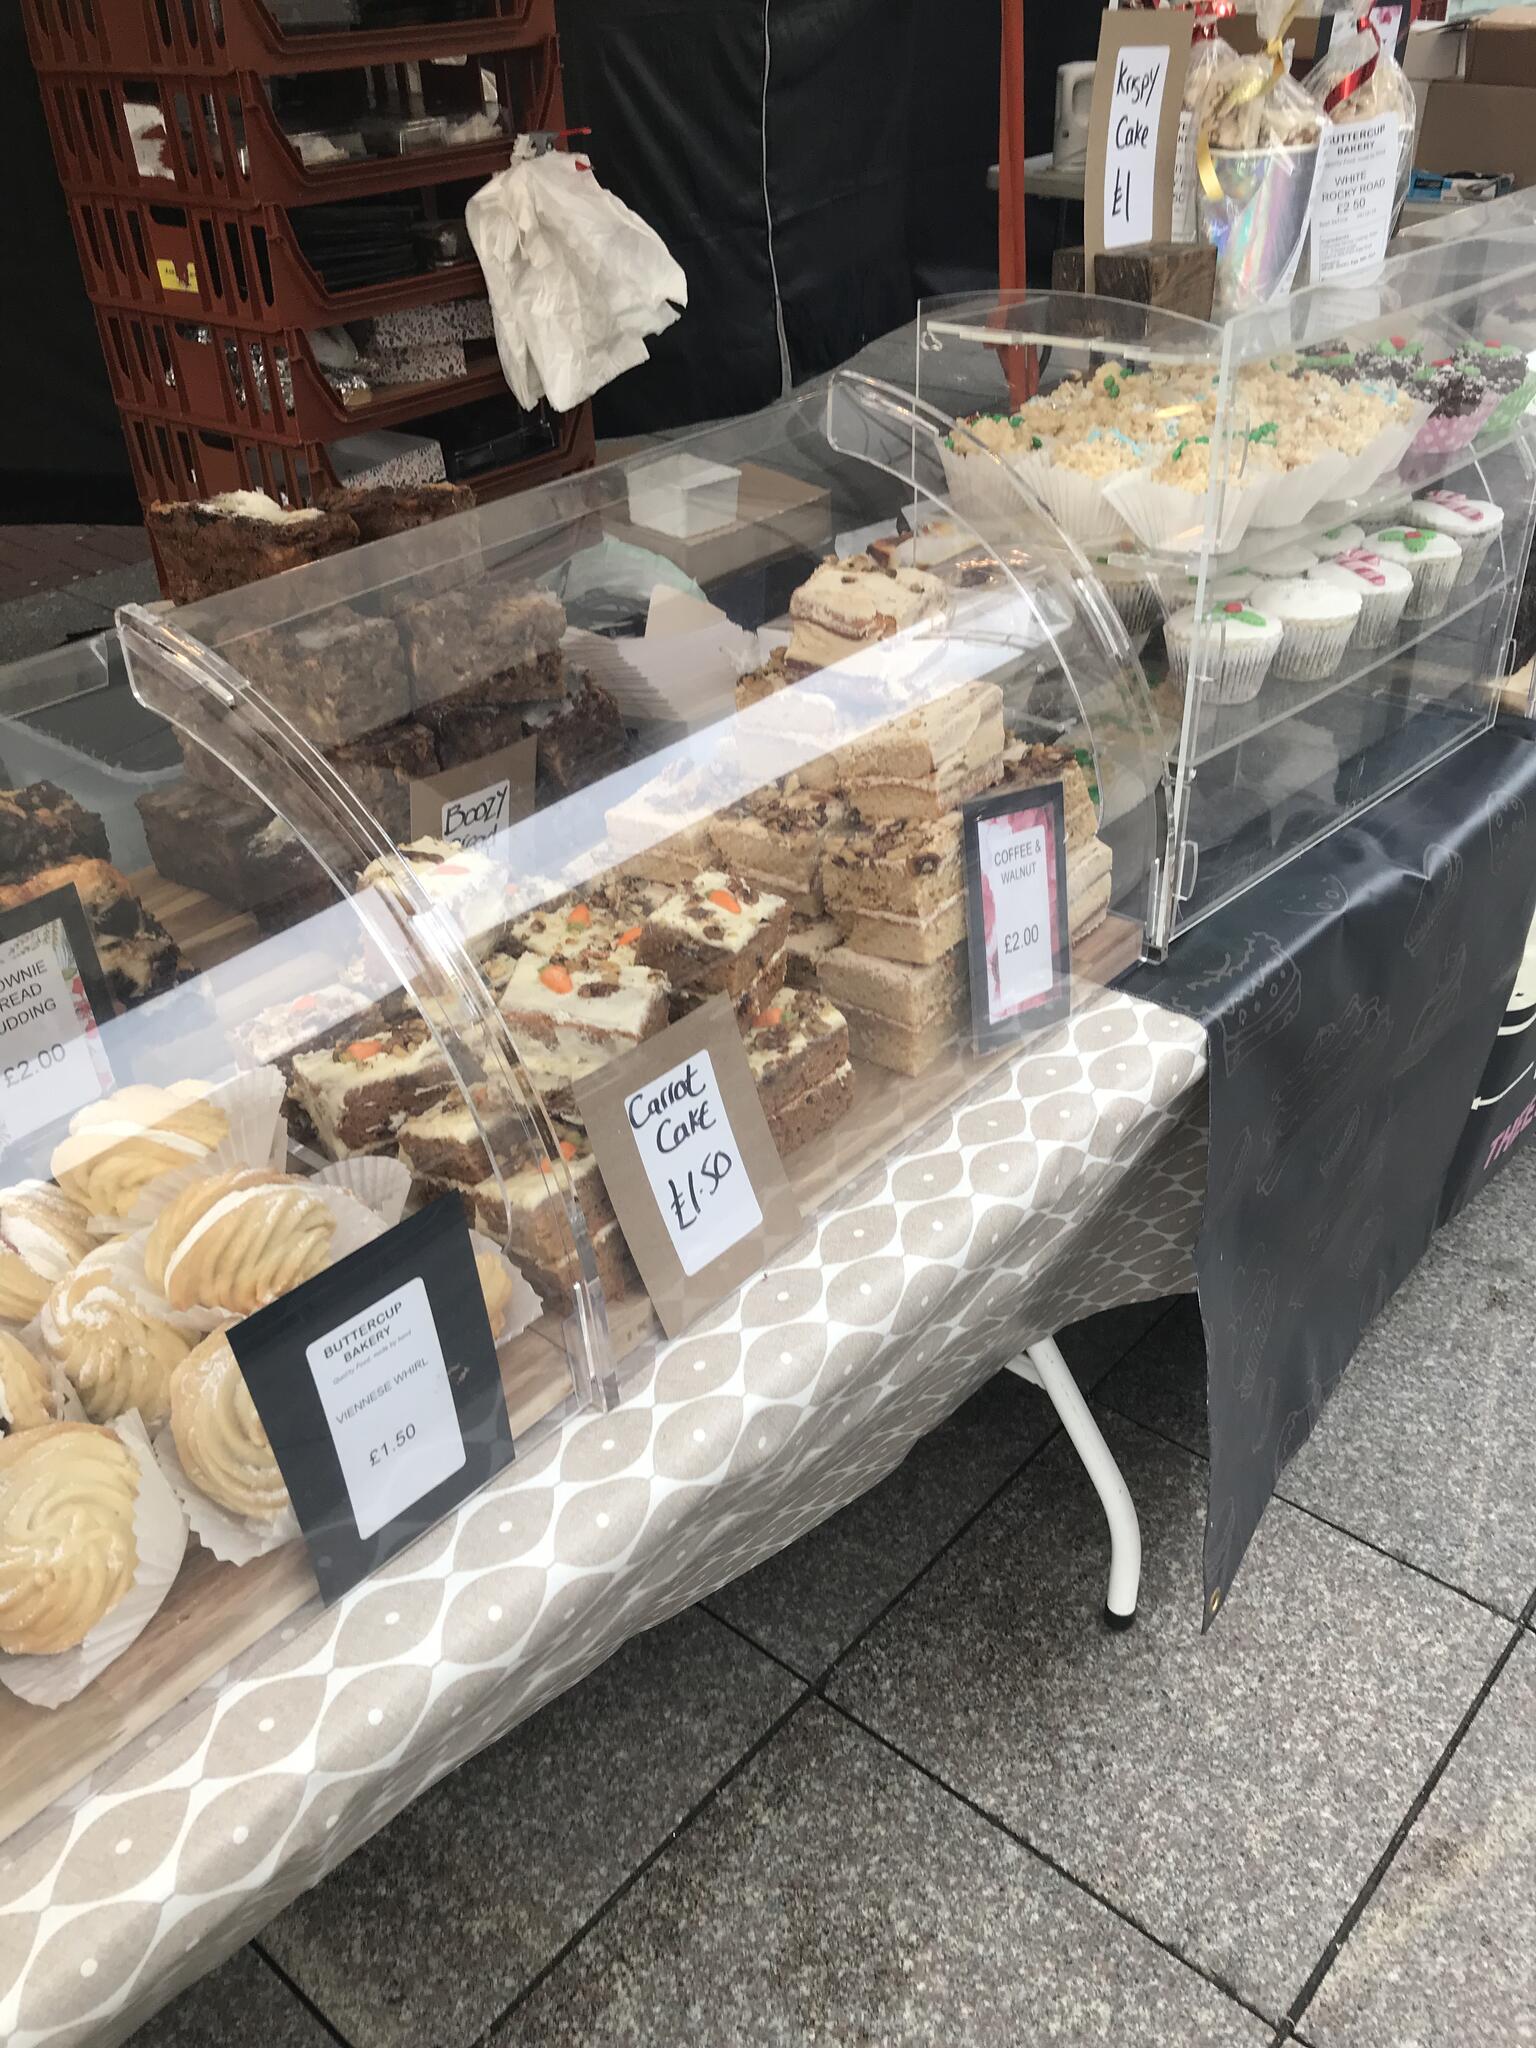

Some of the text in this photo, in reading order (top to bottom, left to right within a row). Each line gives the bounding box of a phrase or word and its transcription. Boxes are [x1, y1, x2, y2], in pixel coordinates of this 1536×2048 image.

[1115, 114, 1150, 150] Cake
[1337, 140, 1375, 155] BAKERY
[1112, 167, 1131, 222] £1
[1322, 178, 1386, 202] ROCKY ROAD
[1335, 169, 1366, 187] WHITE
[994, 839, 1042, 867] COFFEE &
[1001, 861, 1037, 886] WALNUT
[1004, 923, 1040, 955] £2.00
[4, 1043, 66, 1088] £2.00
[628, 1064, 706, 1129] Carrot
[668, 1151, 732, 1230] £1.50
[323, 1301, 402, 1359] BUTTERCUP
[344, 1324, 390, 1363] BAKERY
[336, 1357, 429, 1424] VIENNESE WHIRL
[369, 1423, 417, 1467] £1.50
